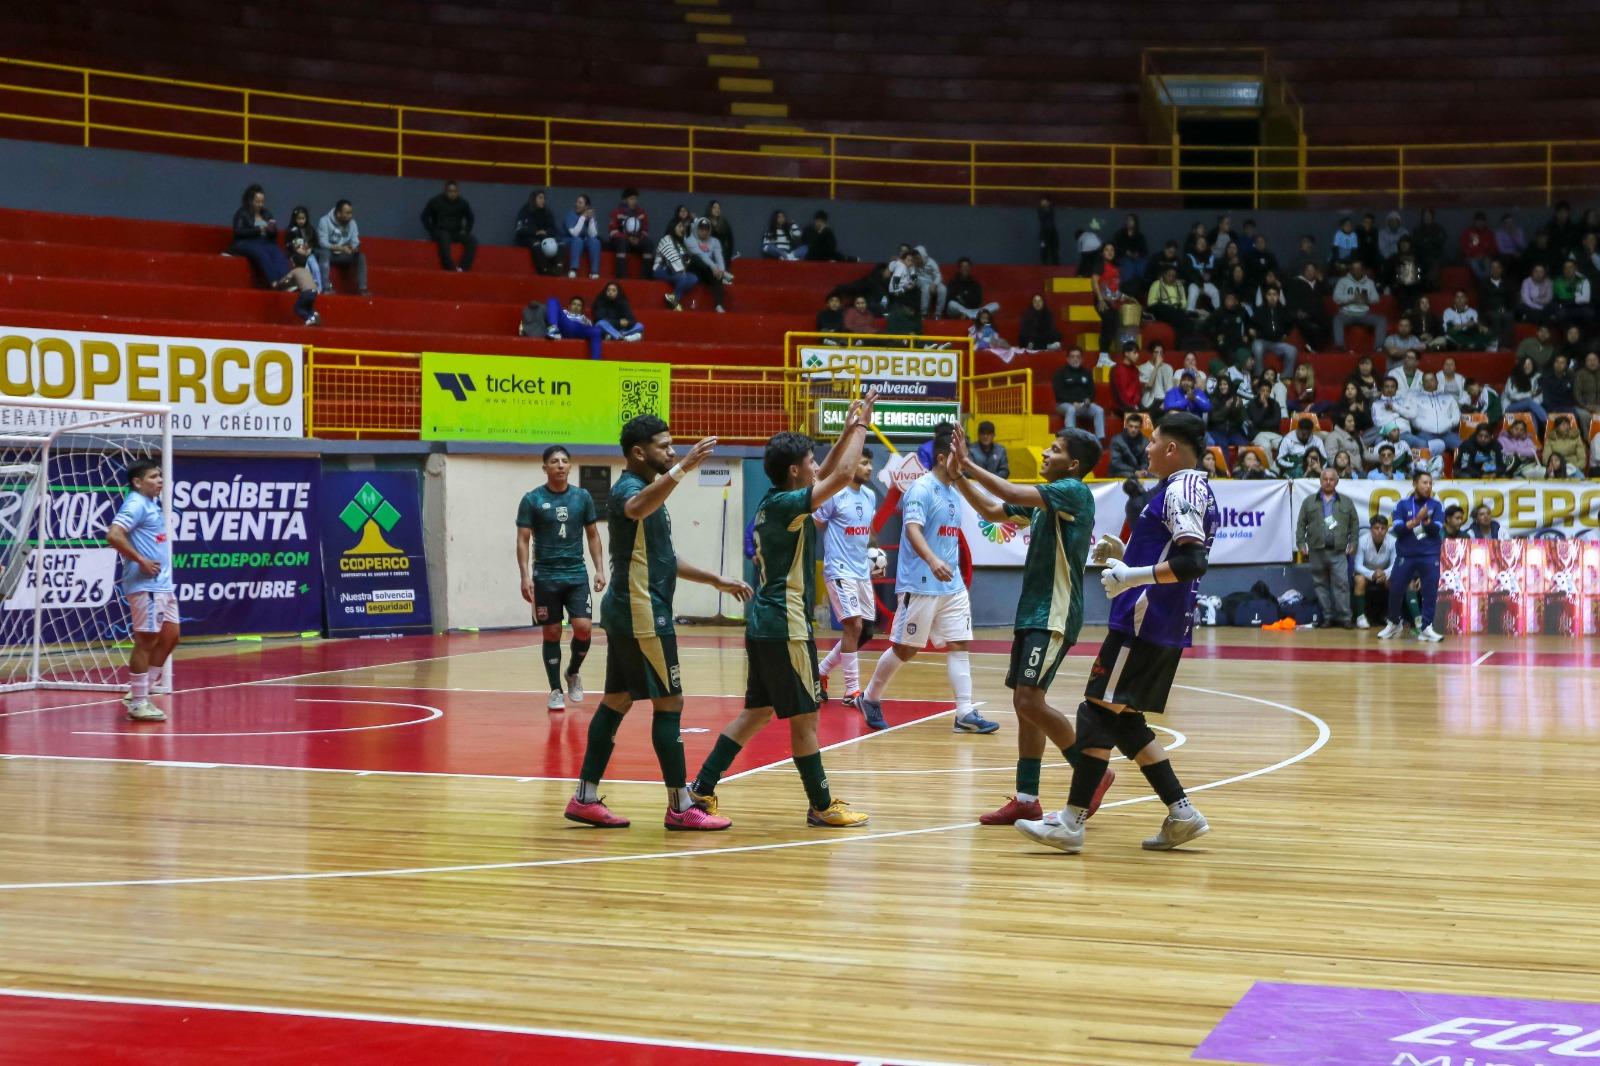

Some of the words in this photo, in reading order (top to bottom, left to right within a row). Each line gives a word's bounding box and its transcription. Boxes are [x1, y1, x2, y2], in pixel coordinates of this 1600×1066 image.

[486, 373, 546, 395] ticket
[551, 380, 571, 396] in
[202, 415, 210, 430] Y
[219, 412, 292, 432] CRÉDITO
[172, 474, 311, 509] SCRÍBETE
[557, 523, 567, 539] 4
[1230, 530, 1253, 538] vidas
[26, 554, 80, 571] NGHT
[340, 556, 409, 571] COOPERCO
[27, 571, 75, 588] RACE
[179, 583, 206, 601] DE
[208, 580, 297, 601] OCTUBRE
[375, 591, 413, 600] solvencia
[355, 605, 365, 613] su
[368, 601, 411, 612] seguridad!
[1028, 646, 1042, 667] 5
